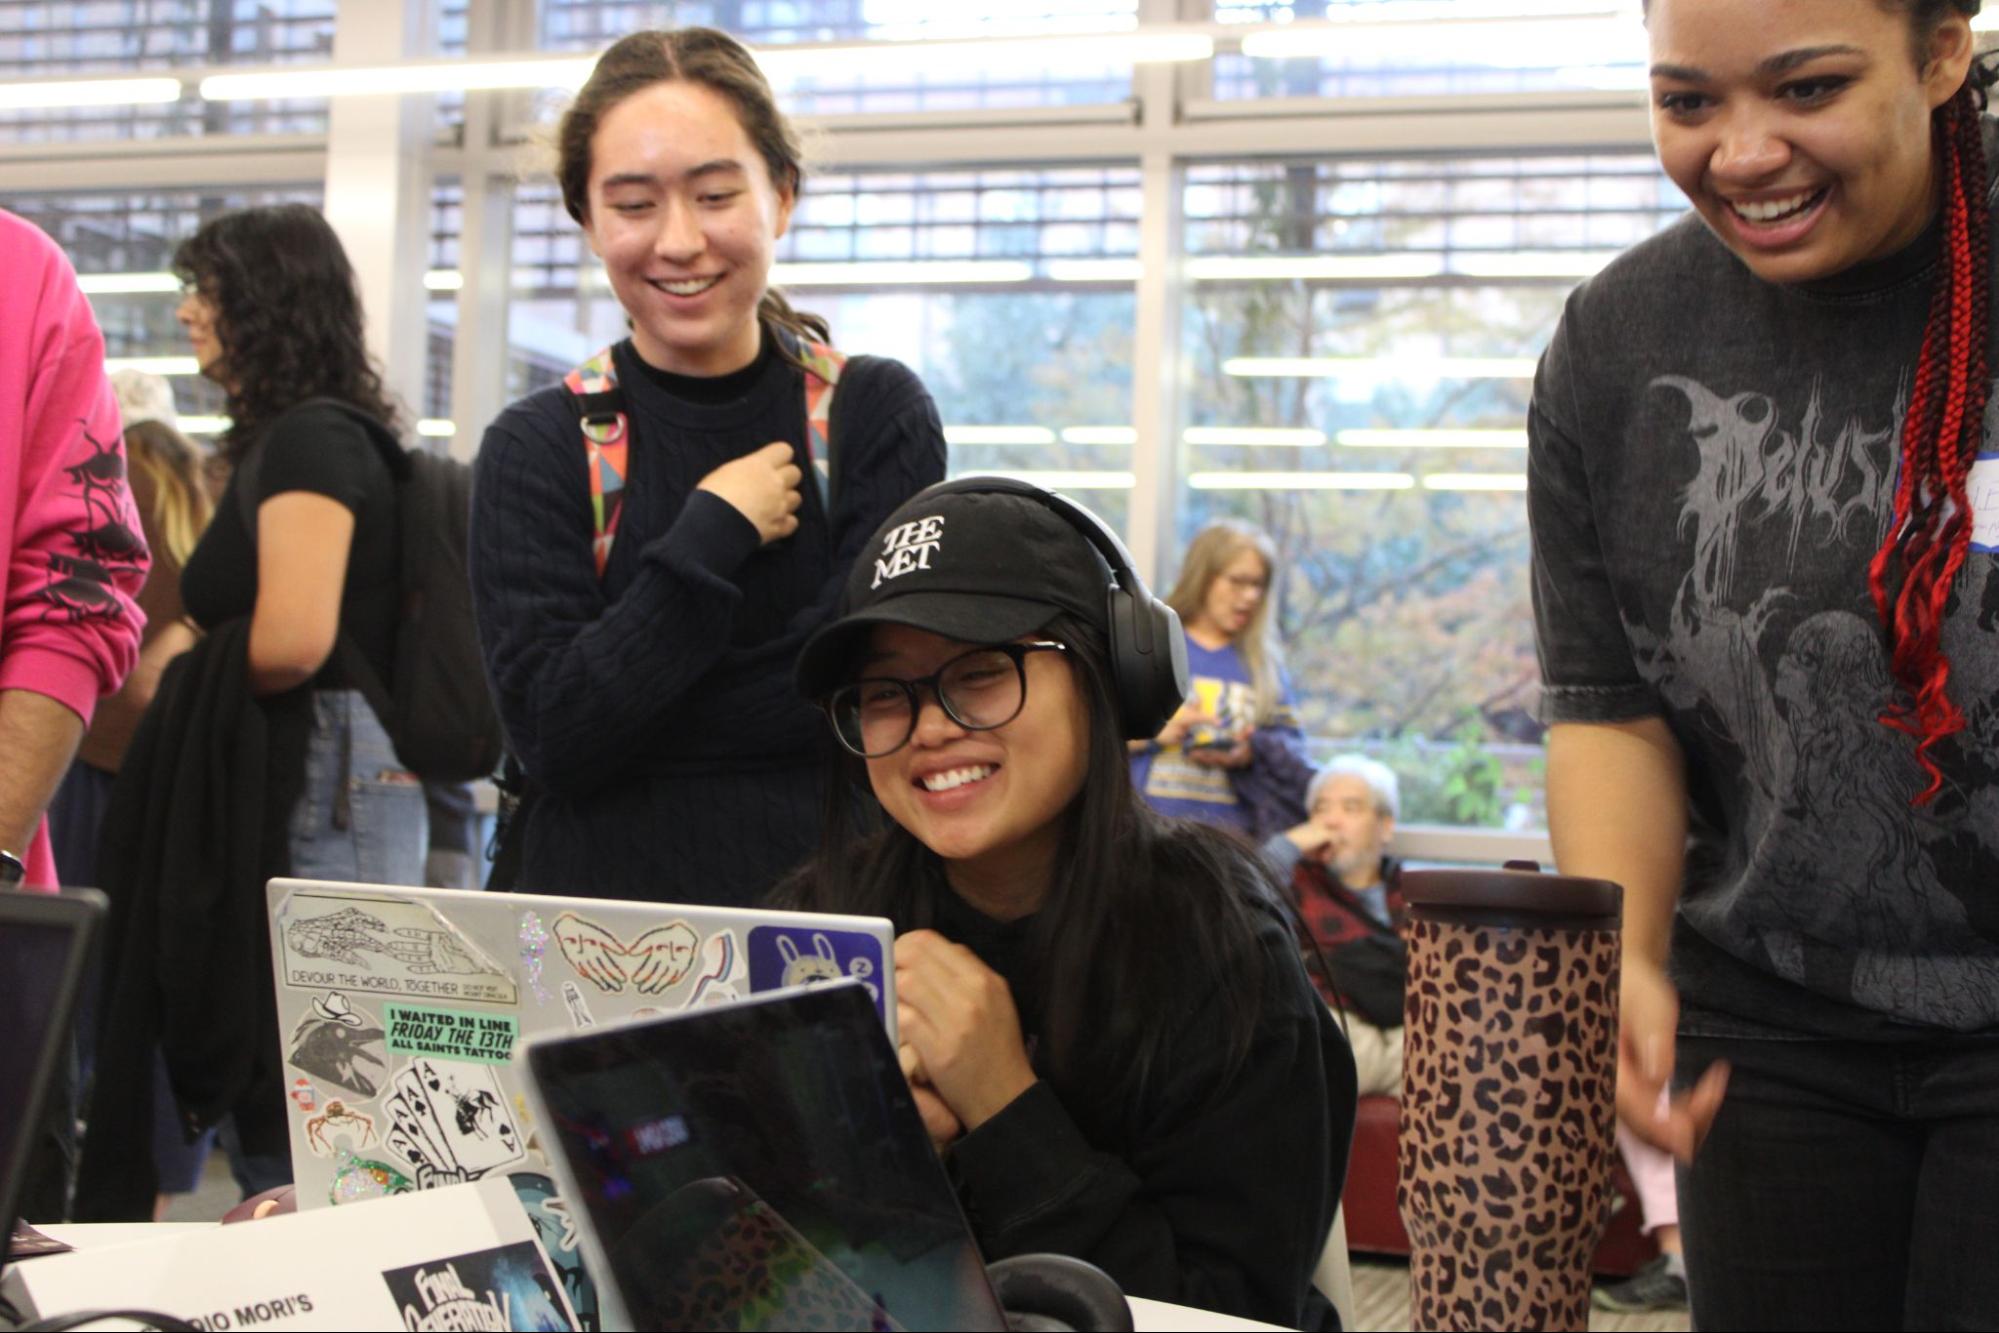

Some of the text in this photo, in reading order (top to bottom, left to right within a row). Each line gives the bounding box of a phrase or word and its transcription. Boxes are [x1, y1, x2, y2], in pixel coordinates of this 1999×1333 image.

[882, 515, 945, 556] THE
[870, 541, 940, 590] MET
[292, 970, 335, 985] DEVOUR
[338, 973, 358, 987] THE
[405, 979, 458, 995] TOGETHER
[391, 1009, 511, 1033] I WAITED IN LINE
[391, 1022, 513, 1050] FRIDAY THE 13TH
[392, 1039, 413, 1050] ALL
[416, 1042, 460, 1055] SAINTS
[423, 1061, 436, 1079] A
[234, 1293, 314, 1327] MORI'S
